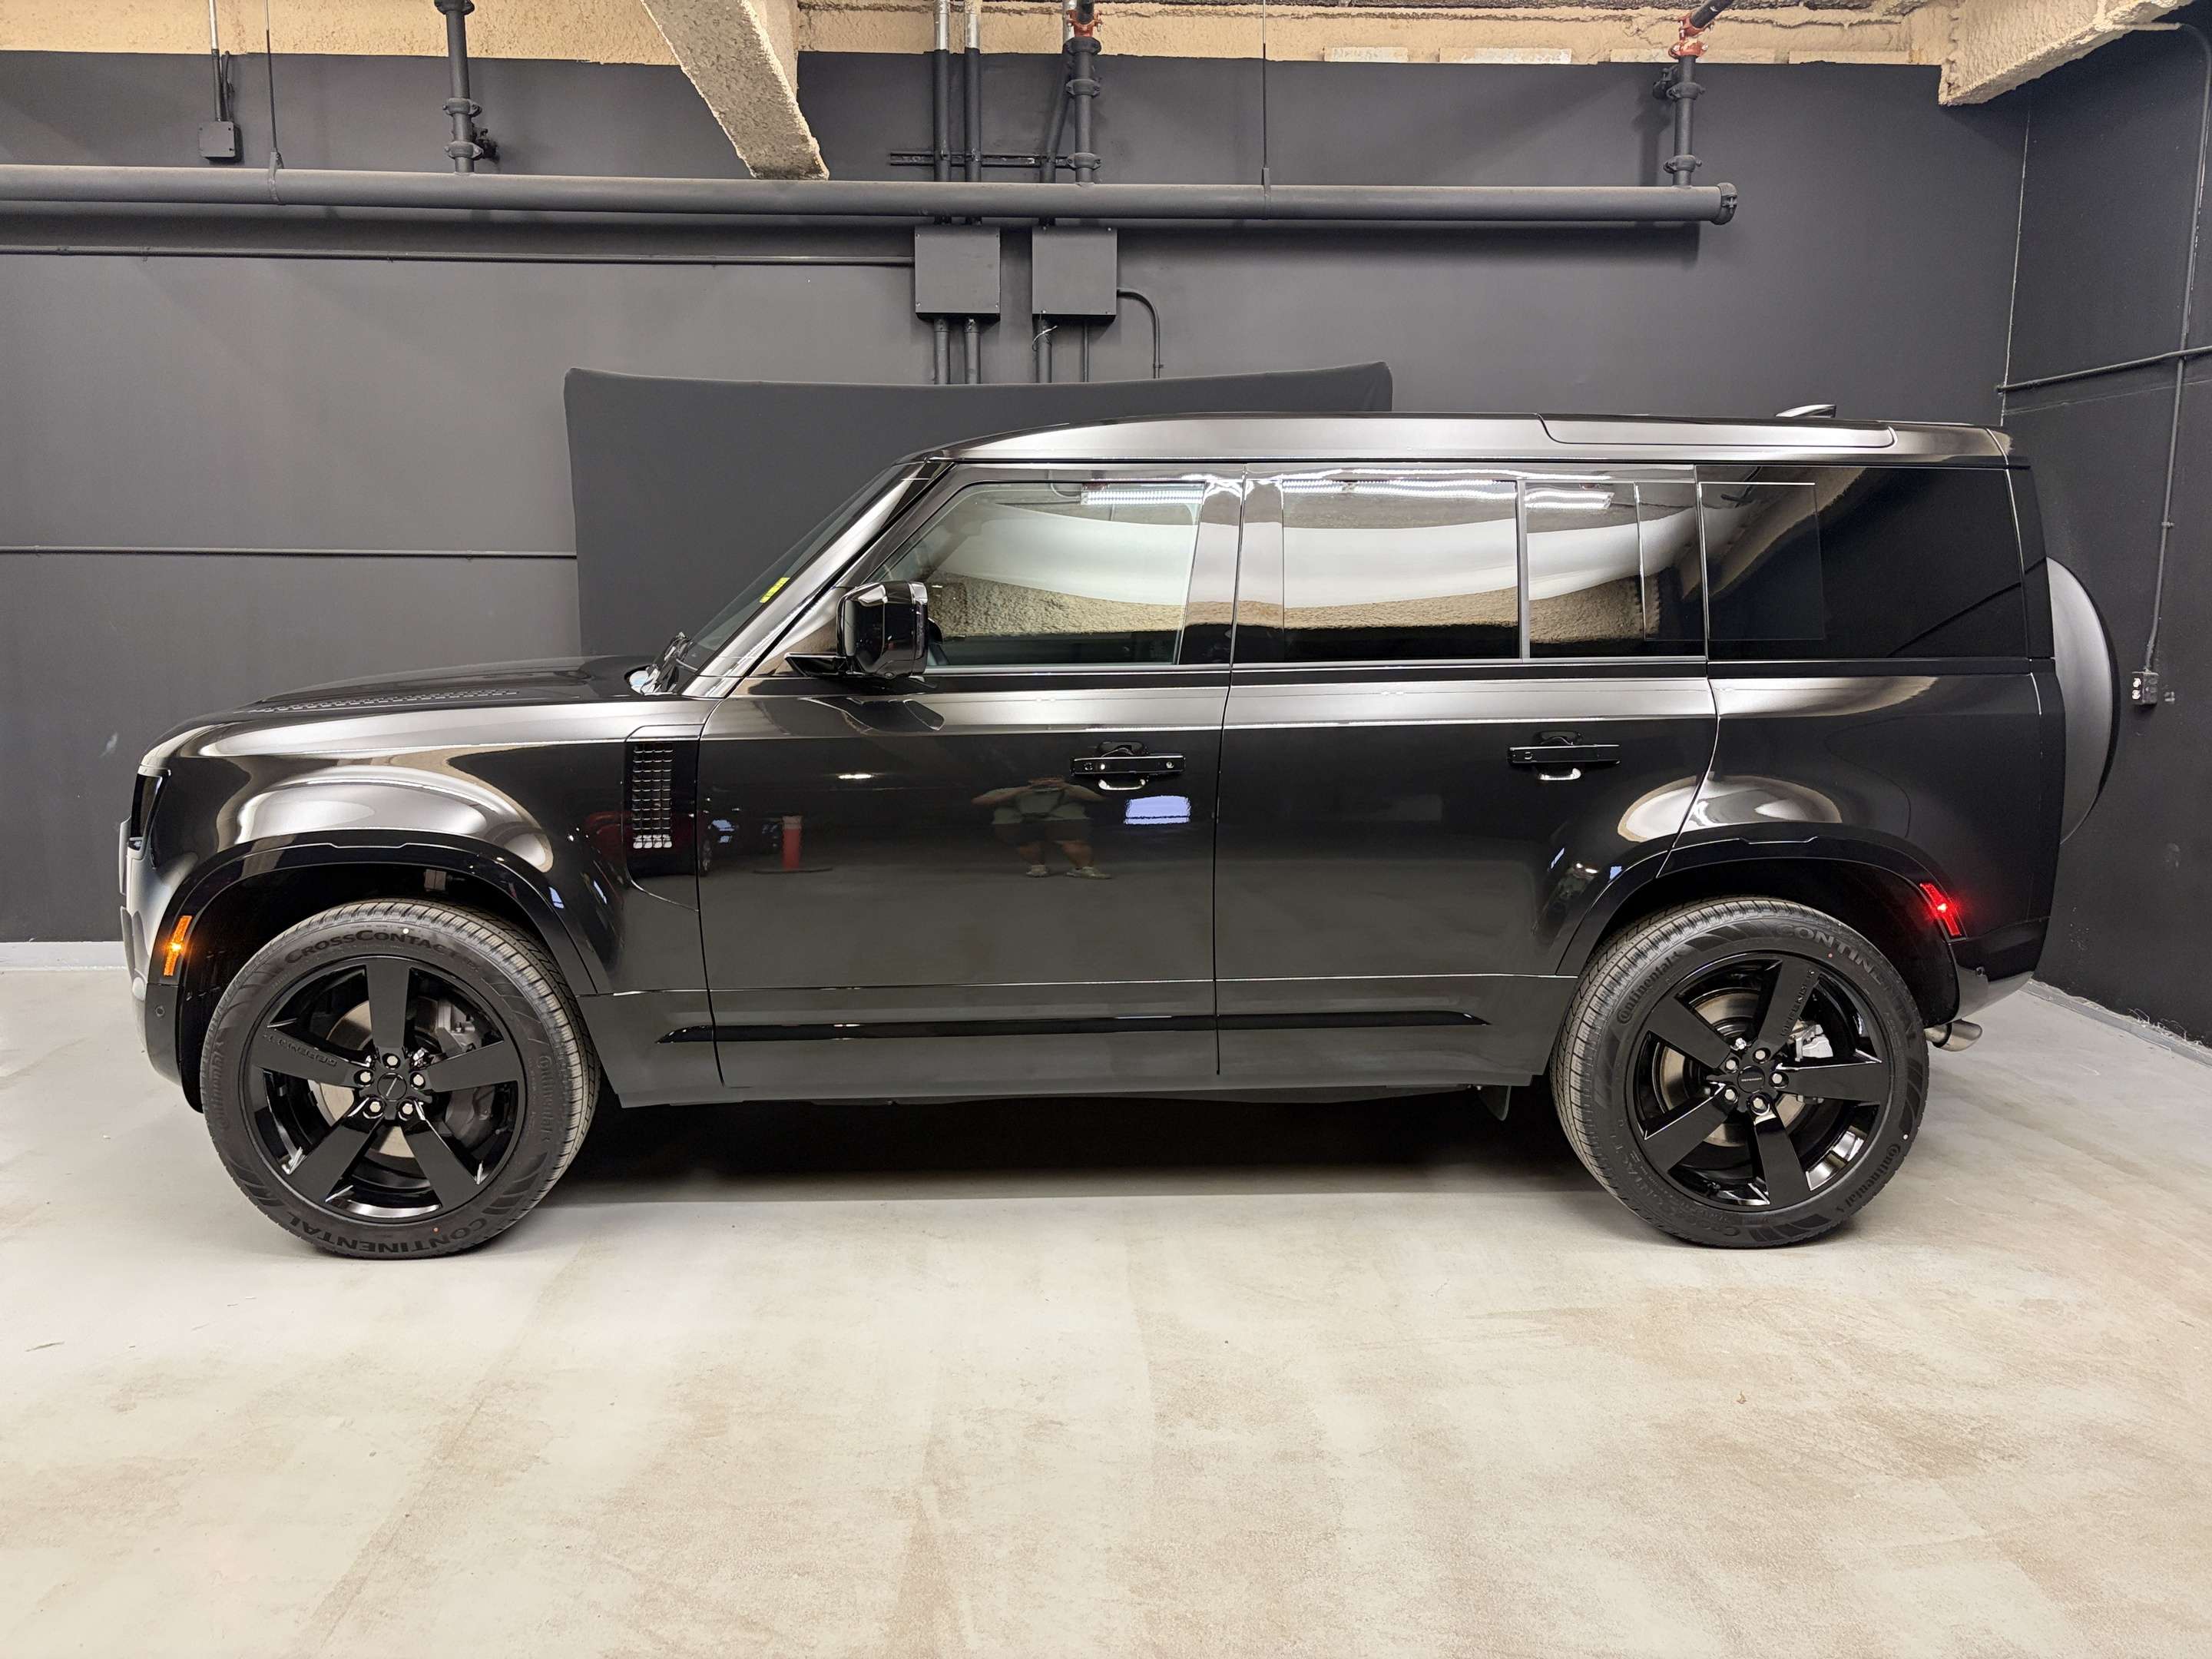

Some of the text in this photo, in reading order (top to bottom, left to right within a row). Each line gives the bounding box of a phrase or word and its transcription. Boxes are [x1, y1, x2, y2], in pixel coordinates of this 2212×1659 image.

[1616, 956, 1674, 1025] Continental
[1845, 1143, 1901, 1208] Continental
[286, 1210, 488, 1253] CONTINENTAL
